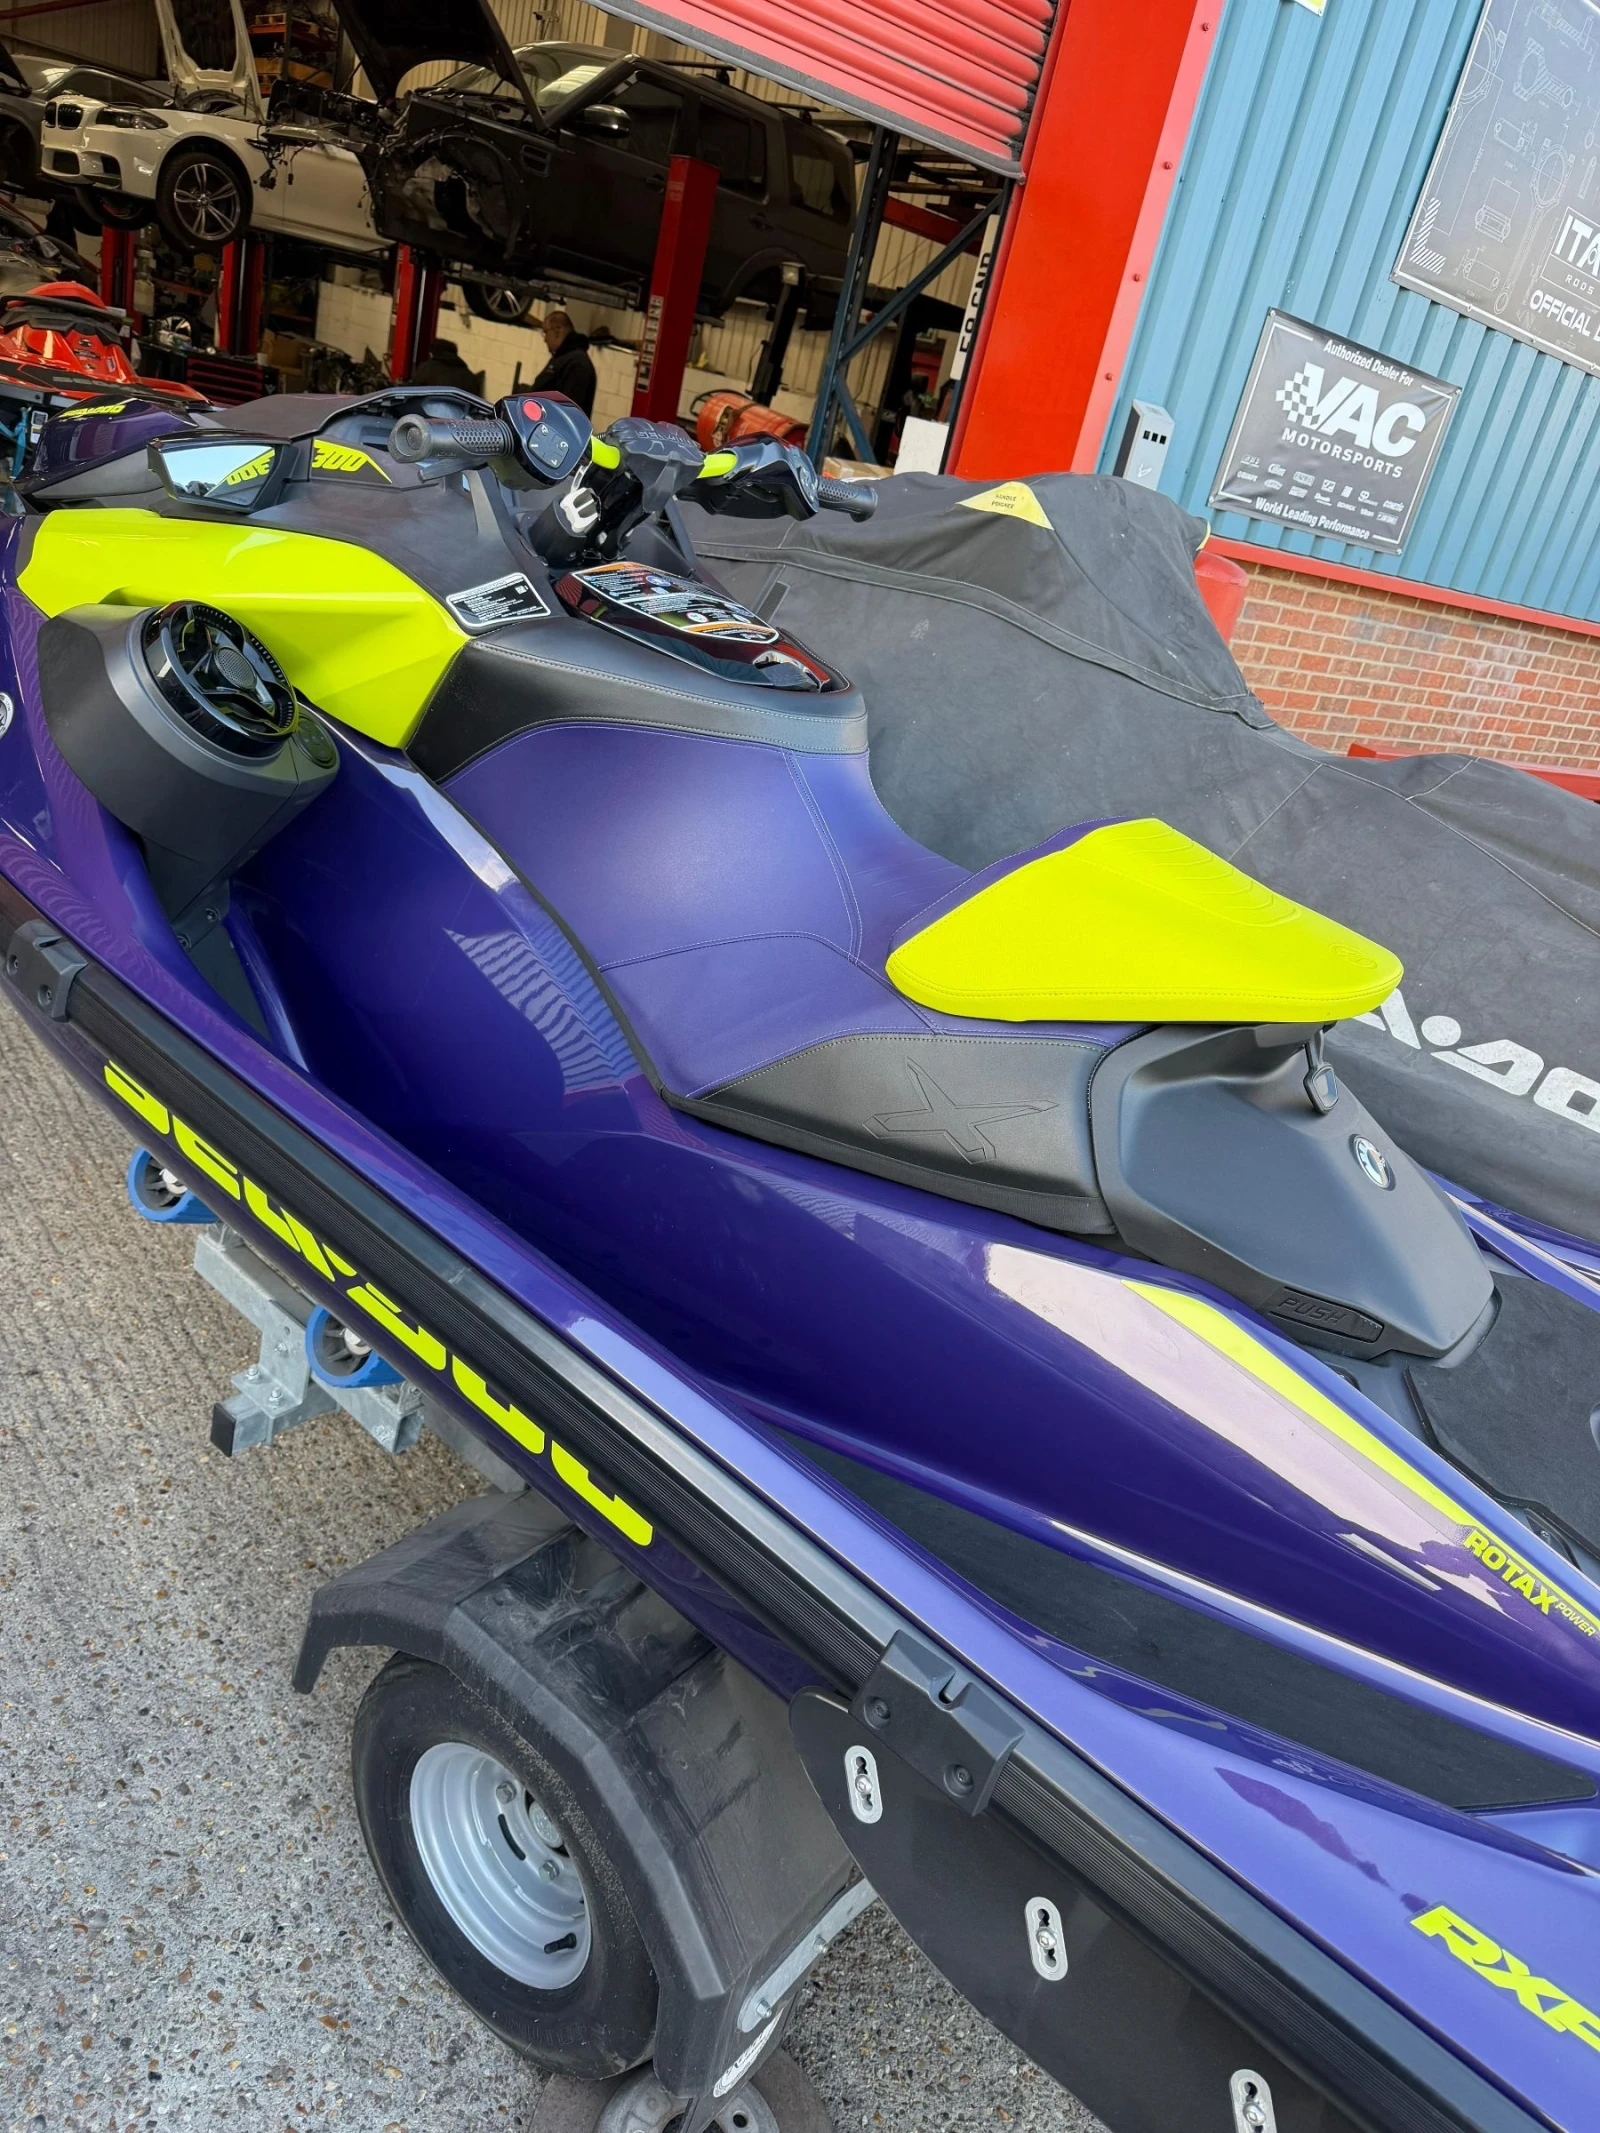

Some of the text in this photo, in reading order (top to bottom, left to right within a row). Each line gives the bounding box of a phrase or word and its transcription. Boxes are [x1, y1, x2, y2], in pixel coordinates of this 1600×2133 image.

[1564, 273, 1595, 296] RODS
[1529, 289, 1591, 337] OFFICIAL
[1323, 339, 1413, 387] Authorized Dealer For
[1276, 361, 1426, 458] VAC
[311, 445, 366, 472] 300
[1281, 427, 1404, 479] MOTORSPORTS
[1254, 497, 1281, 515] World
[1282, 504, 1317, 528] Leading
[1316, 515, 1370, 541] Performance
[1278, 1297, 1348, 1326] PUSH
[1463, 1529, 1597, 1637] ROTAX POWER
